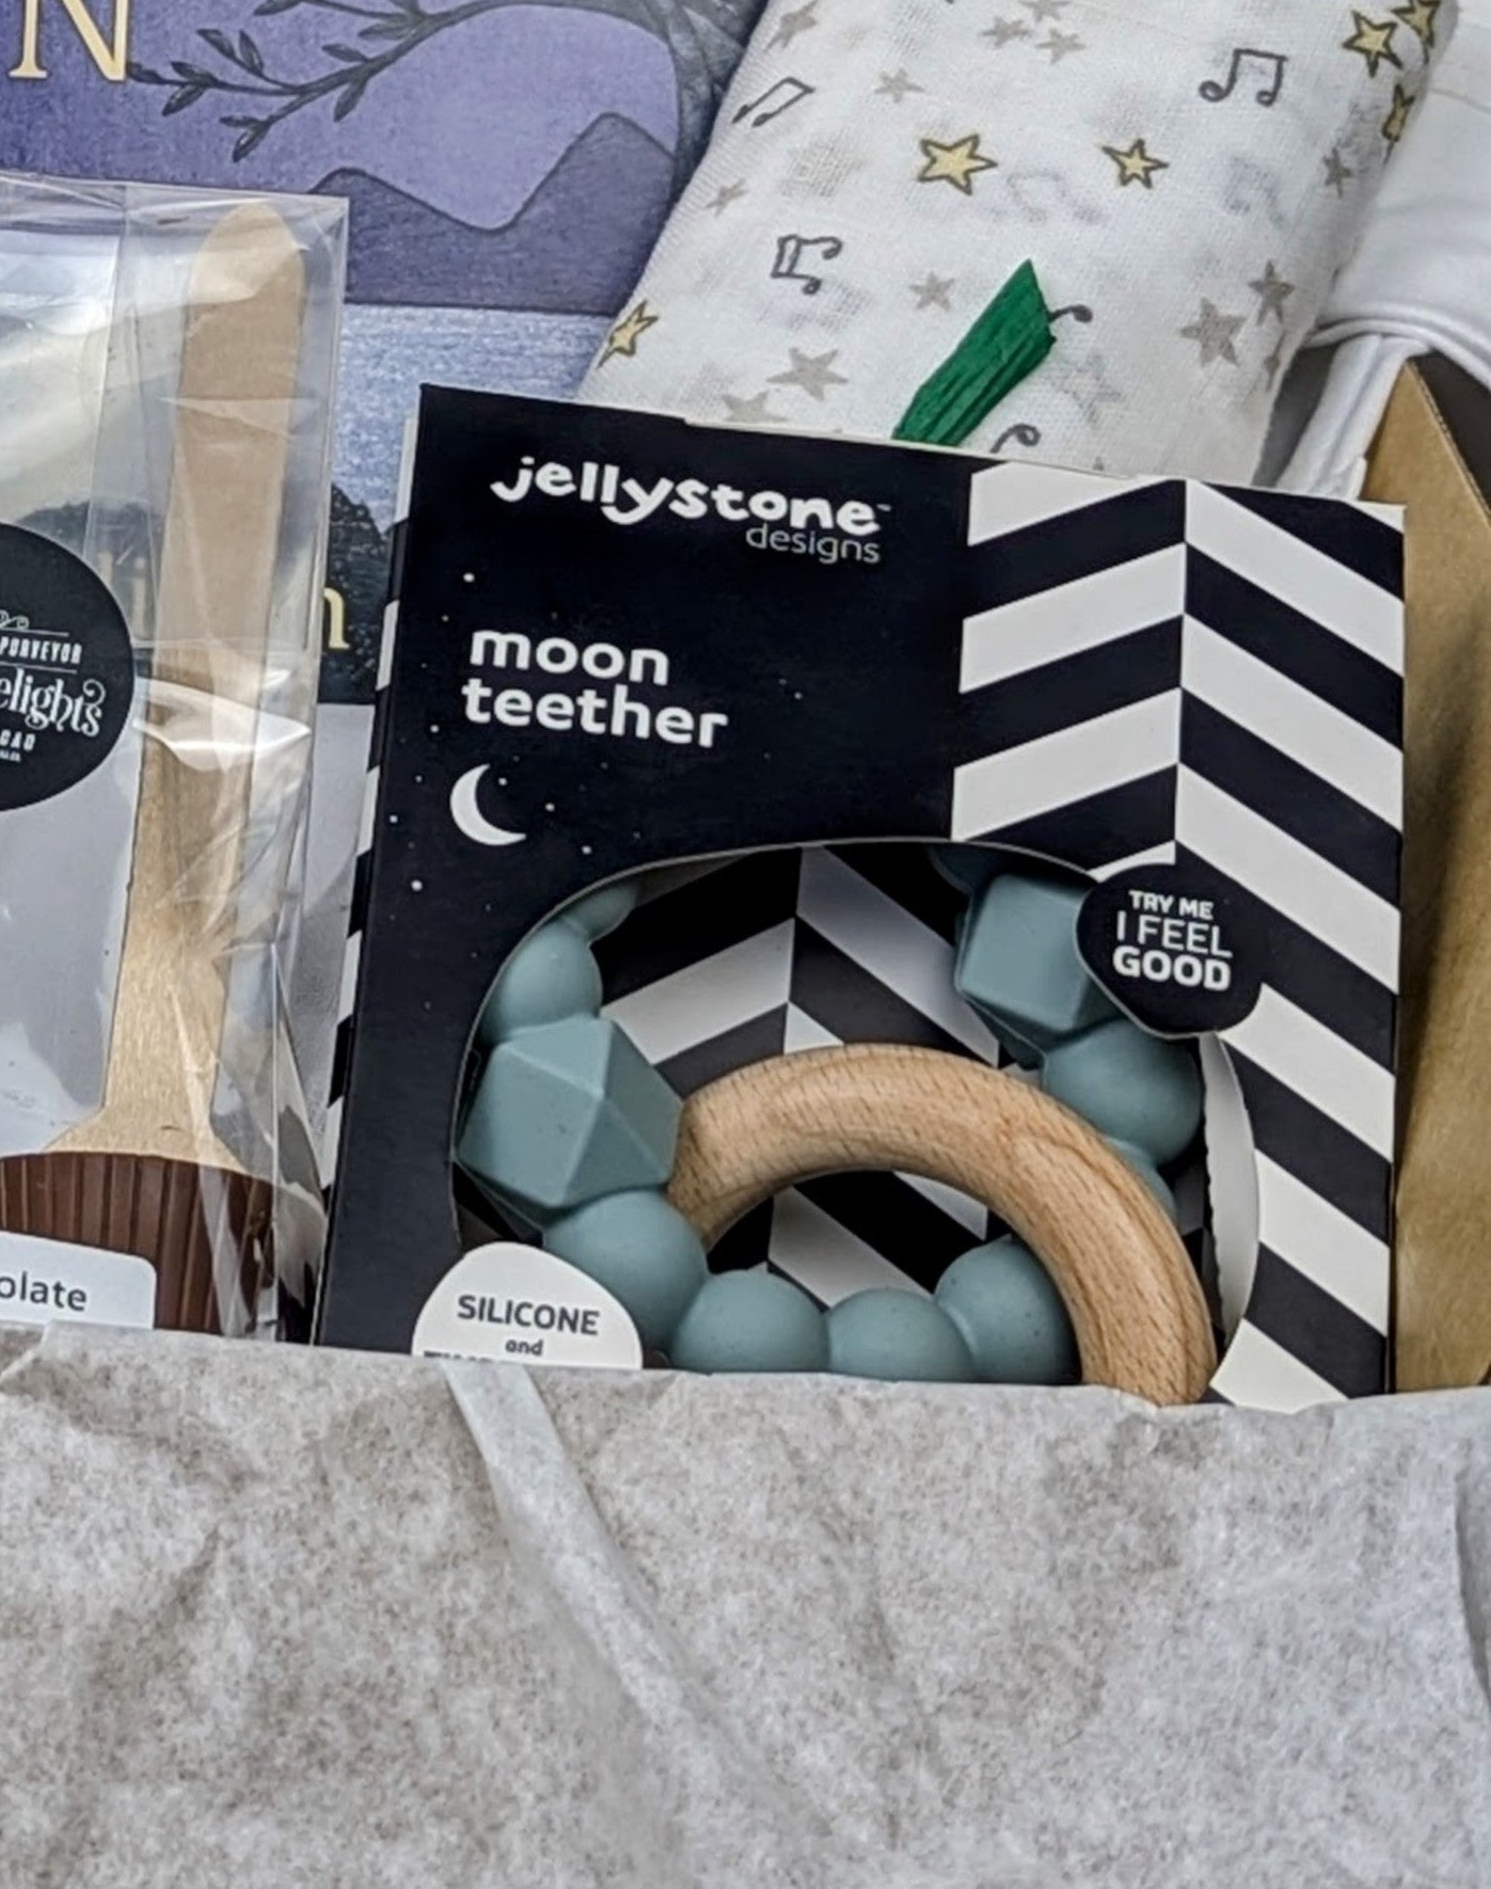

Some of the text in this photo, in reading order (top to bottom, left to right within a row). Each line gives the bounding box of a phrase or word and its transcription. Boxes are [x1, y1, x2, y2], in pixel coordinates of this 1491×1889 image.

[490, 456, 881, 536] jellystone
[745, 523, 881, 564] designs
[469, 629, 669, 686] moon
[461, 675, 728, 748] teether
[1129, 889, 1214, 920] TRY ME
[1116, 910, 1233, 959] I FEEL
[1112, 946, 1231, 991] GOOD
[457, 1295, 601, 1336] SILICONE
[505, 1339, 543, 1357] and
